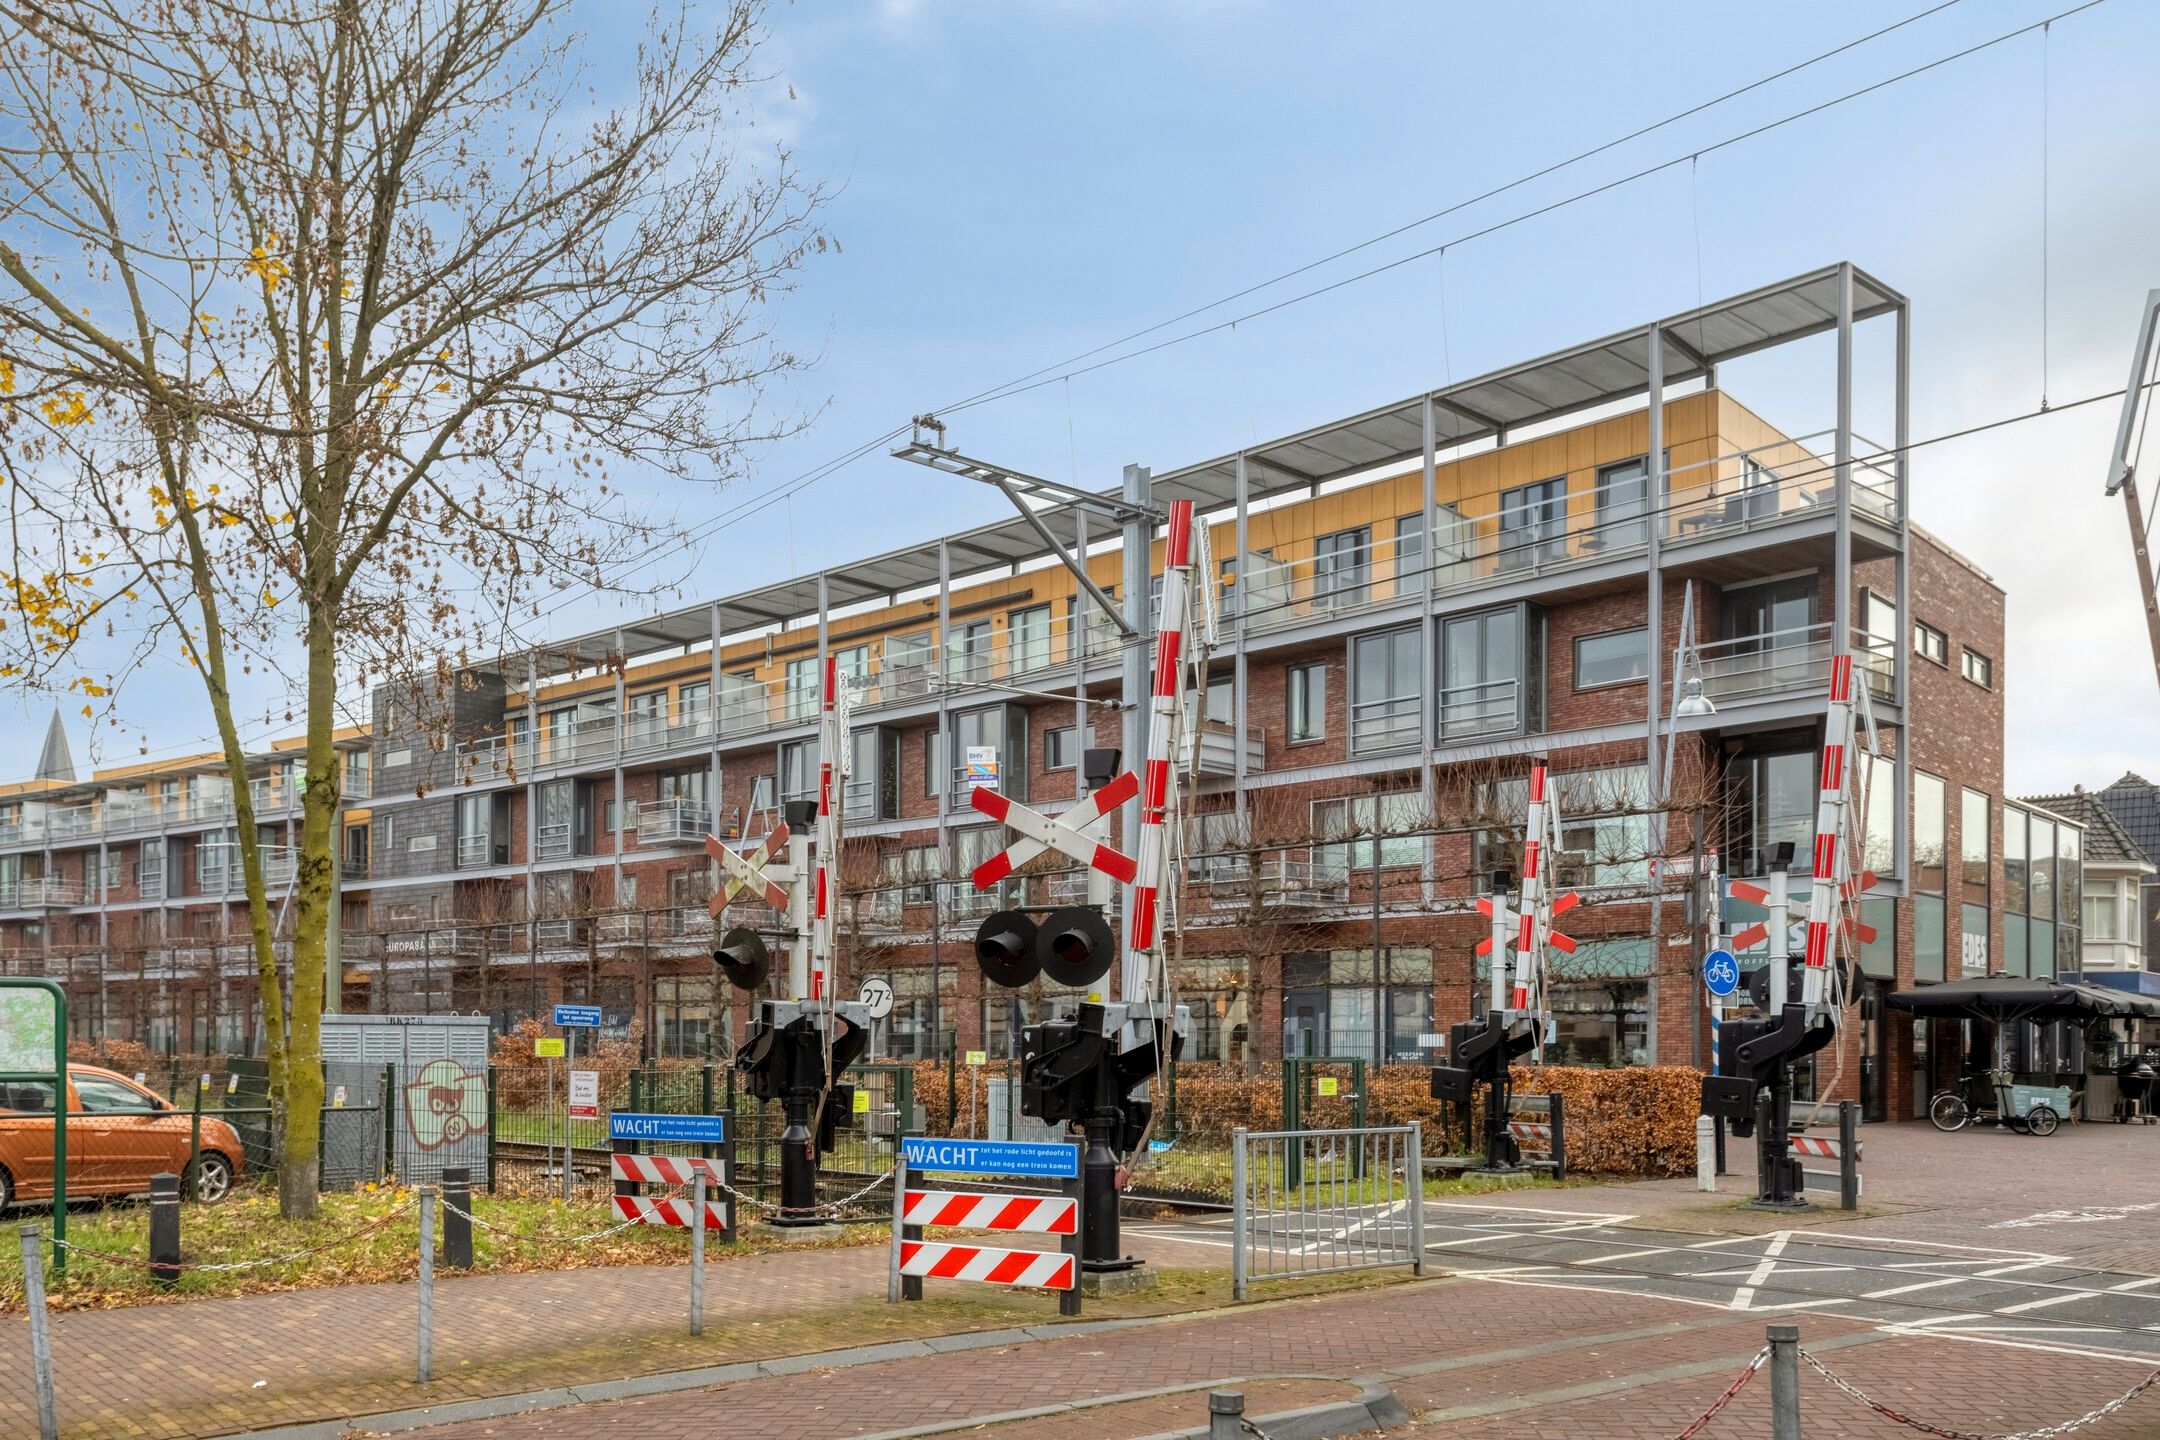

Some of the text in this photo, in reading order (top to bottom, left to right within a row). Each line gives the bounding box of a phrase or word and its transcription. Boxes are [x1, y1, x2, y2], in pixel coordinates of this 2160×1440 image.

[386, 940, 437, 952] UROPABAN
[1962, 932, 1987, 968] EDES
[613, 1119, 659, 1134] WACHT
[907, 1145, 978, 1166] WACHT
